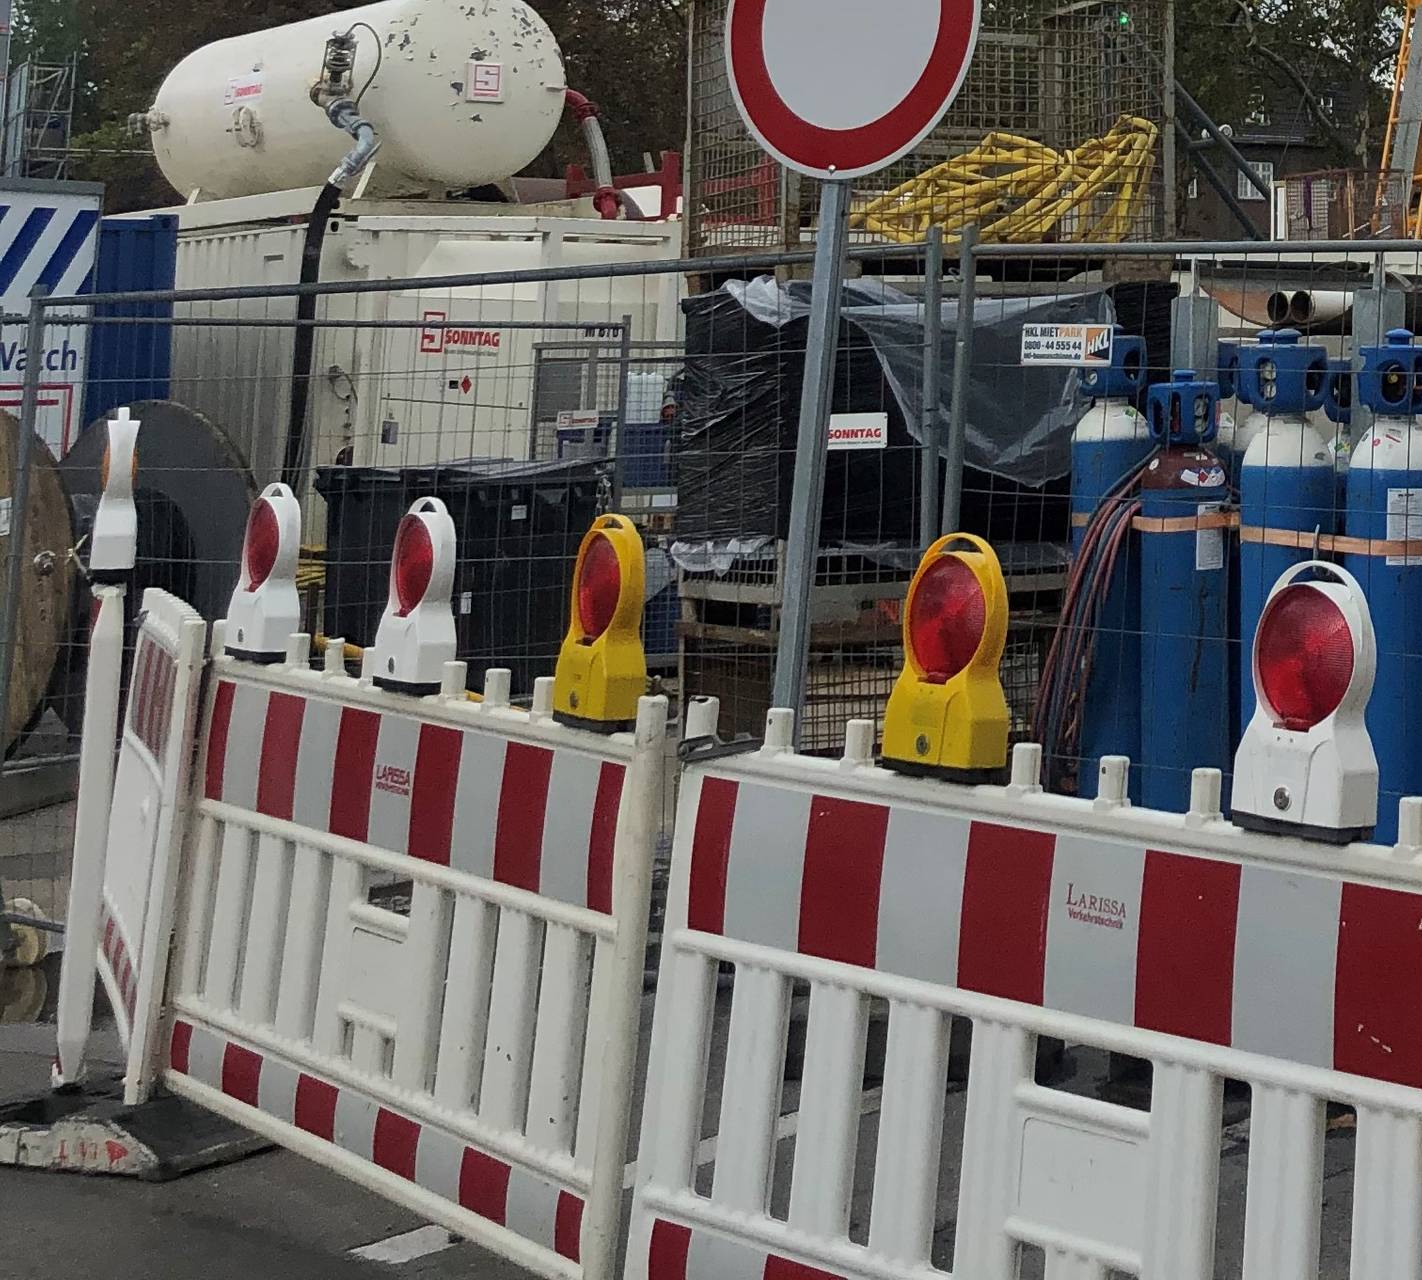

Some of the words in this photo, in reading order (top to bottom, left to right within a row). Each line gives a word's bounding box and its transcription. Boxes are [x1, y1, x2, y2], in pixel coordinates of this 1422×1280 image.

[445, 329, 500, 347] SONNTAG
[1025, 327, 1039, 337] HKL
[1041, 327, 1082, 337] MIETPARK
[1087, 327, 1110, 355] HKL
[1046, 341, 1055, 350] 44
[1056, 341, 1071, 350] 555
[1072, 341, 1082, 350] 44
[0, 340, 77, 371] ach
[827, 428, 882, 439] SONNTAG
[1066, 882, 1126, 918] LARISSA
